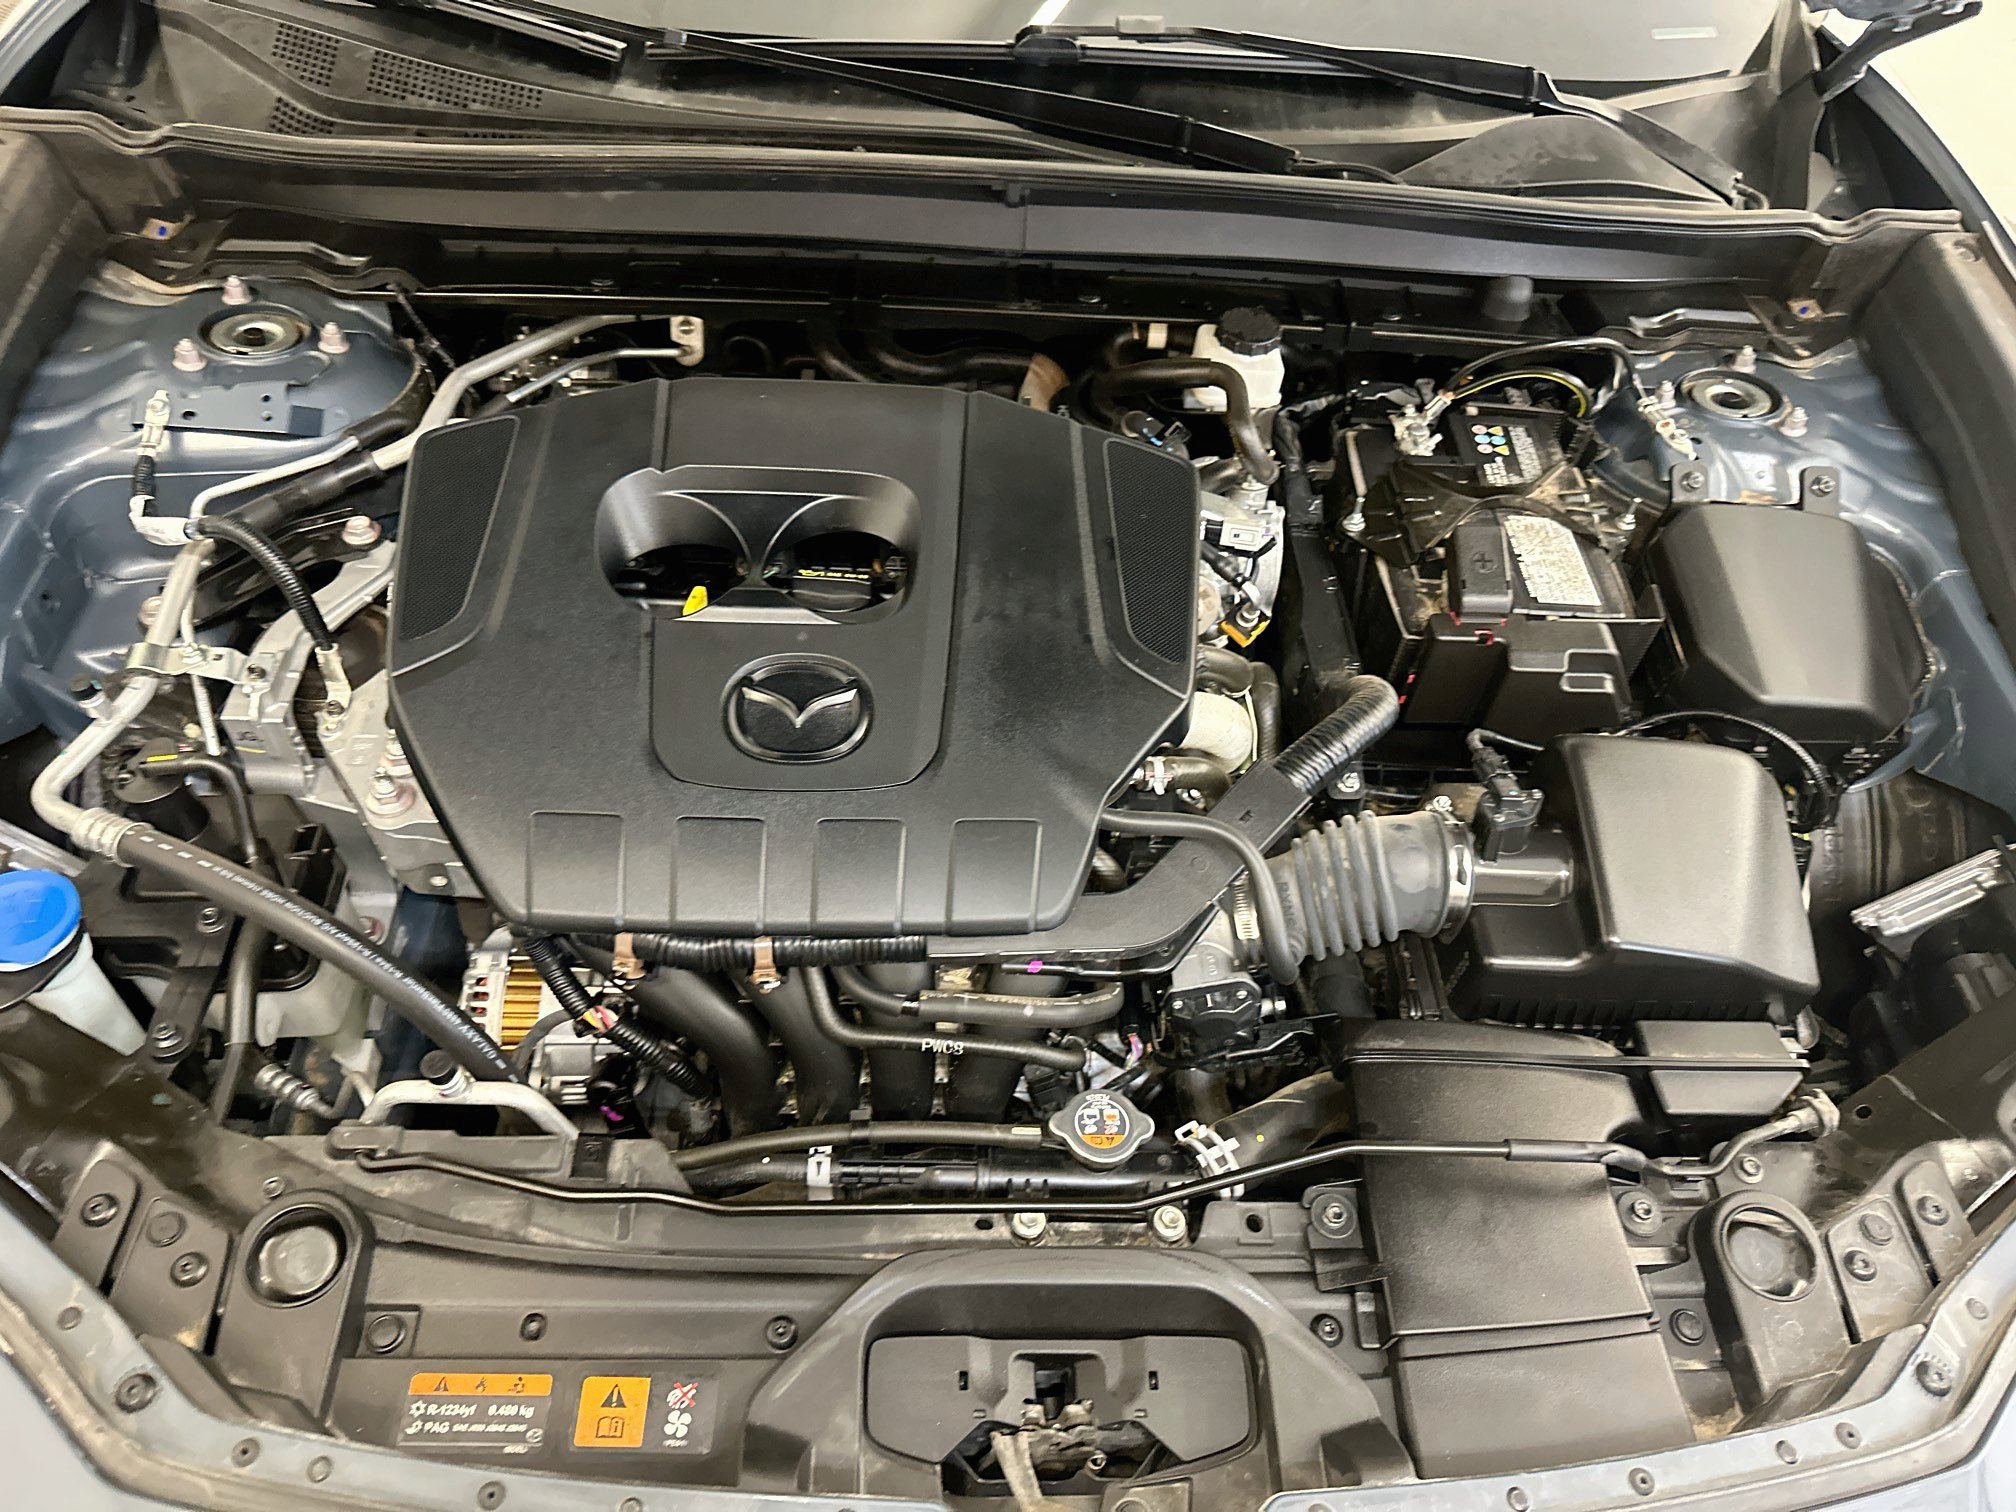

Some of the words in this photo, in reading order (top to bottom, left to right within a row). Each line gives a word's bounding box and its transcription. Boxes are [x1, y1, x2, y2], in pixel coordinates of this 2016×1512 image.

[456, 1020, 498, 1061] GALAXY
[921, 1037, 964, 1055] PWC8
[519, 1404, 535, 1419] kg
[424, 1422, 450, 1434] PAG
